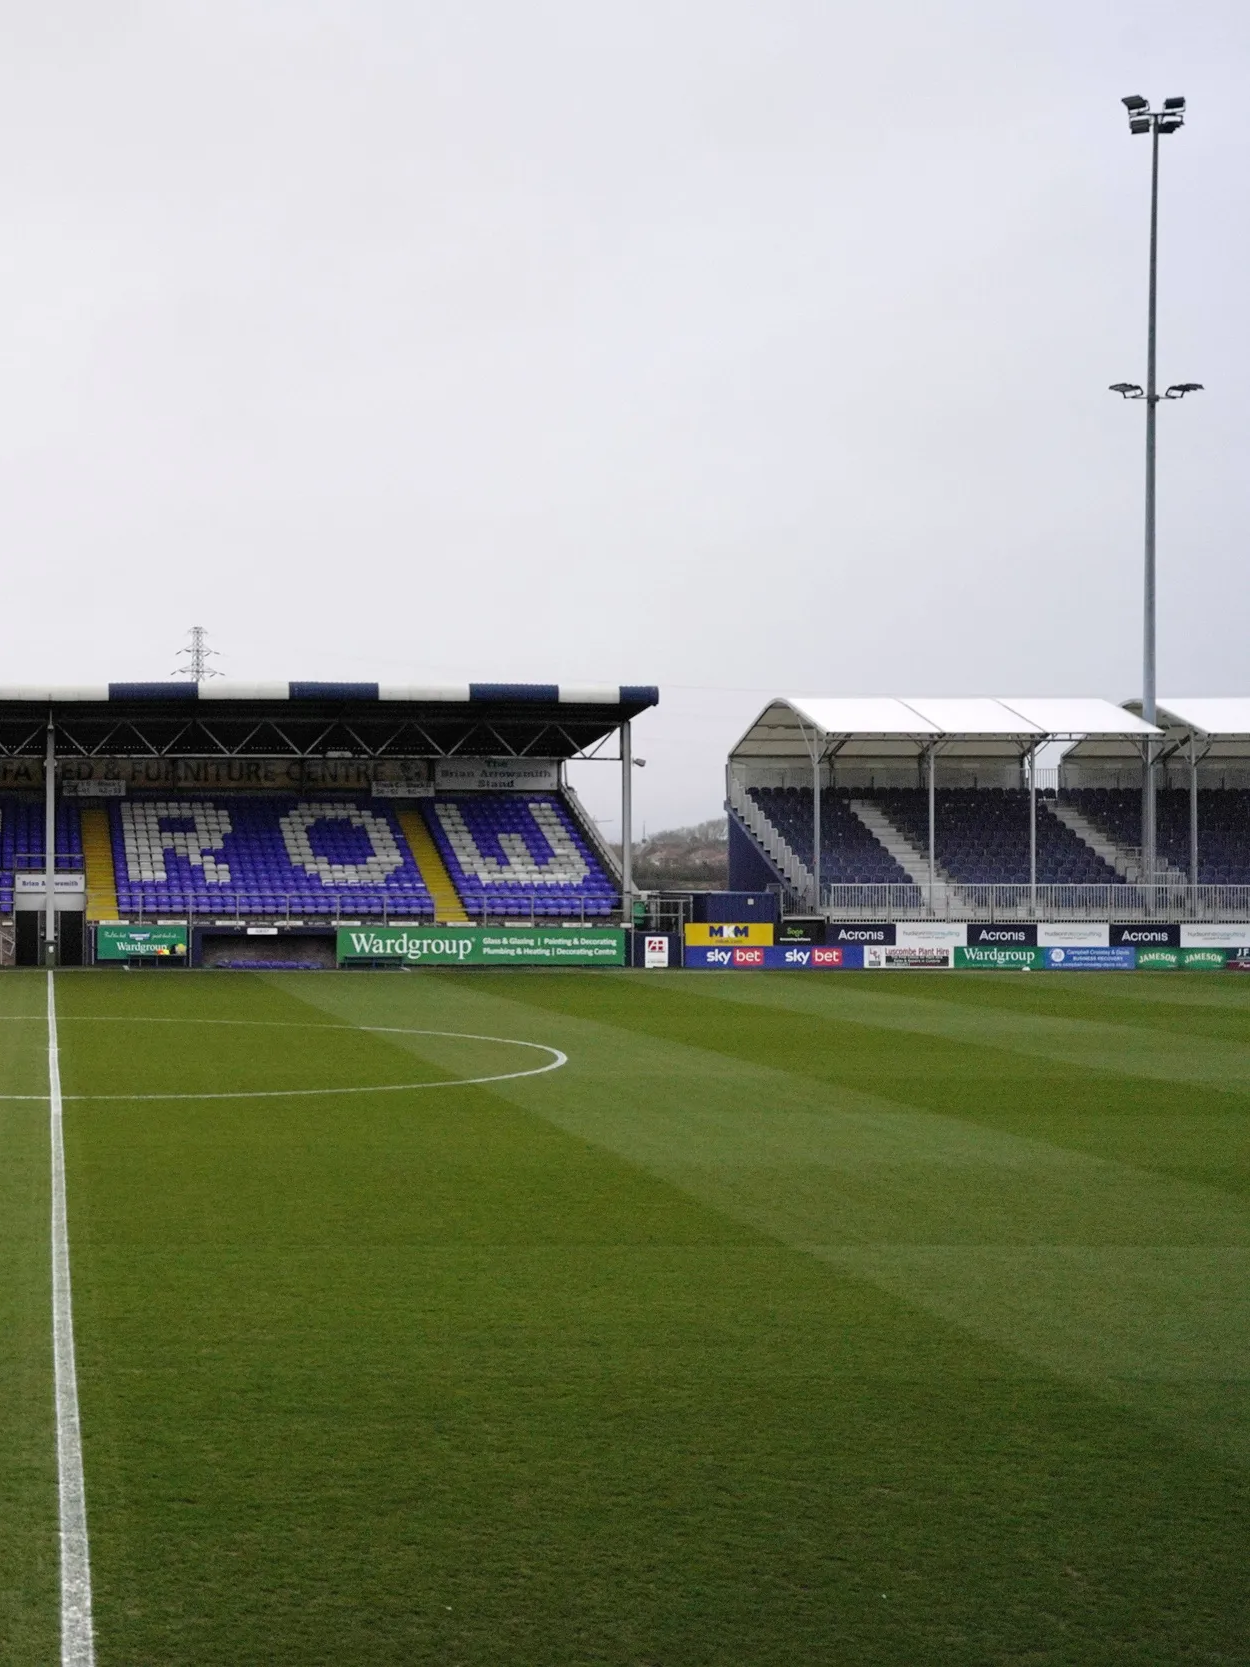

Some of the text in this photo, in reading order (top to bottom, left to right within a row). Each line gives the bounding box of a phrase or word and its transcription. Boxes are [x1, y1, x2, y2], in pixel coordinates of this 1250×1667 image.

[709, 925, 749, 938] MKM
[837, 929, 885, 941] Acronis
[979, 929, 1026, 941] Acronis
[1121, 929, 1169, 942] Acronis
[349, 932, 473, 960] Wardgroup
[482, 937, 617, 947] Glass & Glazing Painting & Decorating
[482, 947, 617, 957] Plumbing & Heating Decorating Centre
[706, 948, 761, 965] sky bet
[785, 948, 839, 965] sky bet
[884, 947, 950, 956] Luscombe Plant Hire
[963, 948, 1036, 964] Wardgroup
[1236, 948, 1242, 956] J
[1138, 952, 1178, 964] JAMESON
[1184, 952, 1224, 964] JAMESON
